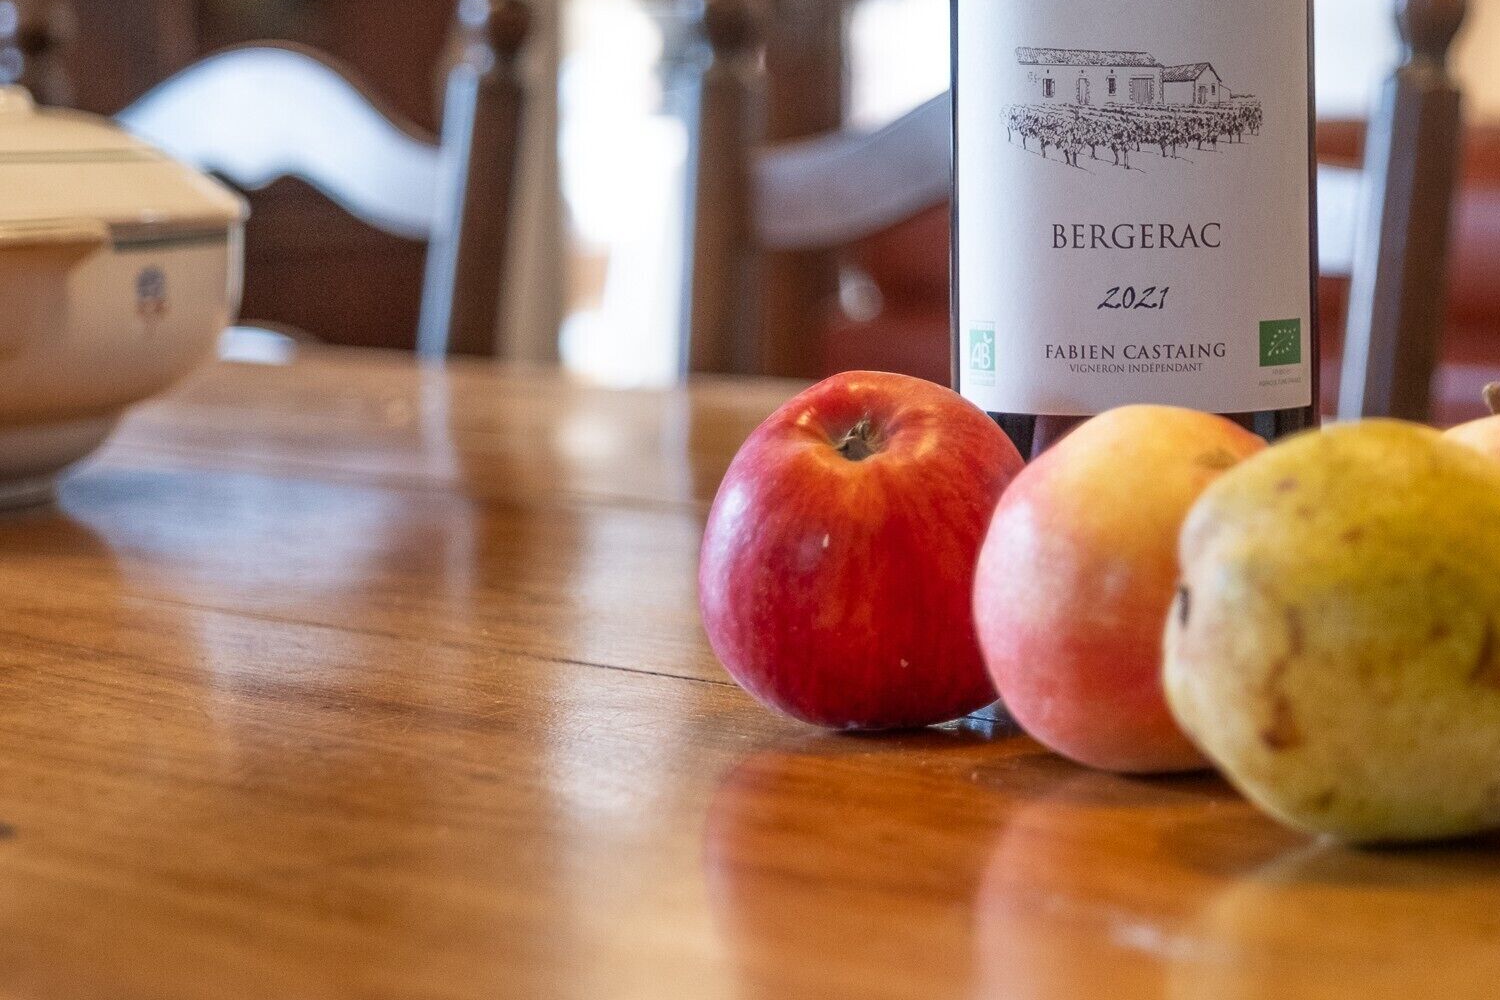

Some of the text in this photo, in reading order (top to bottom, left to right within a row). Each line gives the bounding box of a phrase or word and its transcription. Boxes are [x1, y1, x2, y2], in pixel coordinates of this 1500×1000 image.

[1052, 222, 1221, 250] BERGERAC
[1097, 286, 1170, 310] 2021
[1045, 342, 1226, 360] FABIEN CASTAING
[1069, 363, 1125, 373] VIGNERON
